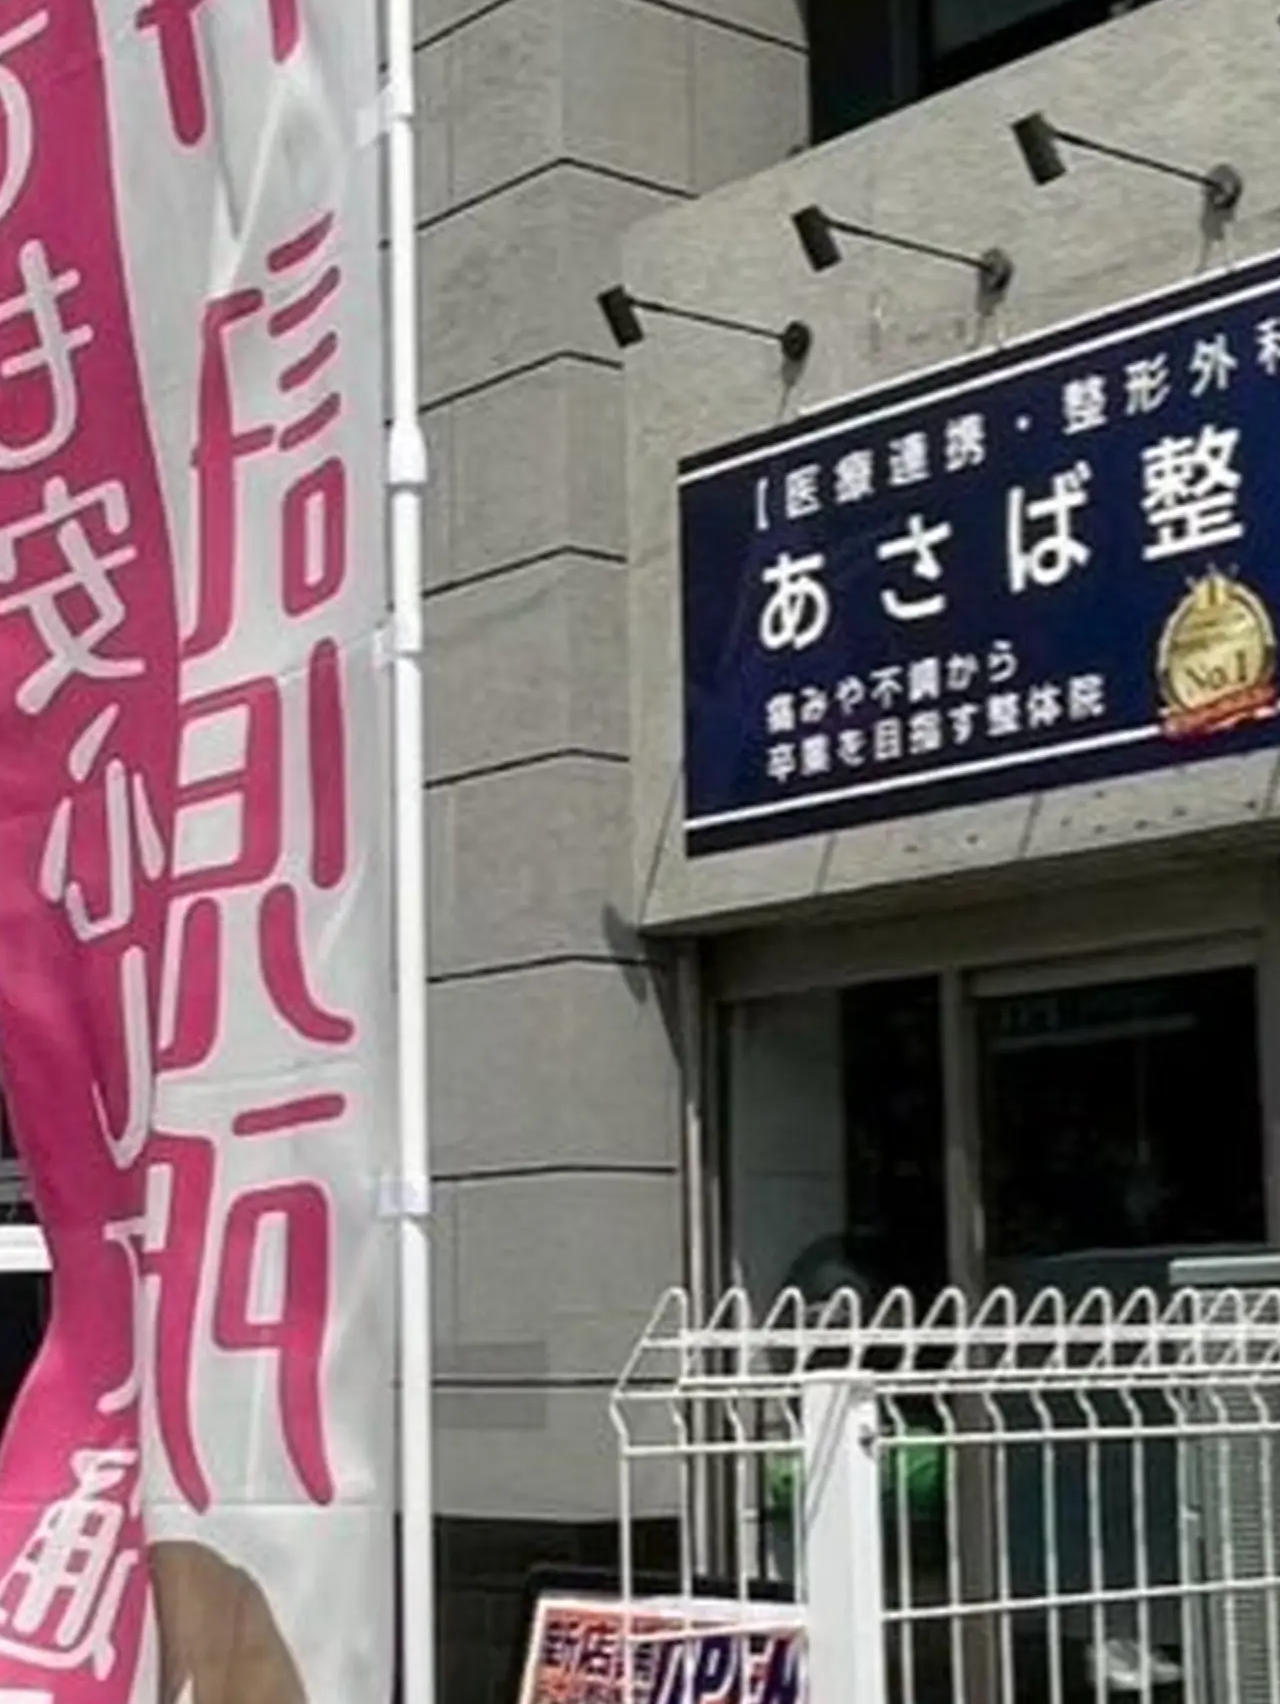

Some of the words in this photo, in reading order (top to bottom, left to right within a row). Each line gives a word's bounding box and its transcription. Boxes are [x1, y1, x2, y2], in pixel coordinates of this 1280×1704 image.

[766, 639, 1018, 733] 痛みや不調から
[766, 673, 1106, 784] 卒業を目指す整体院
